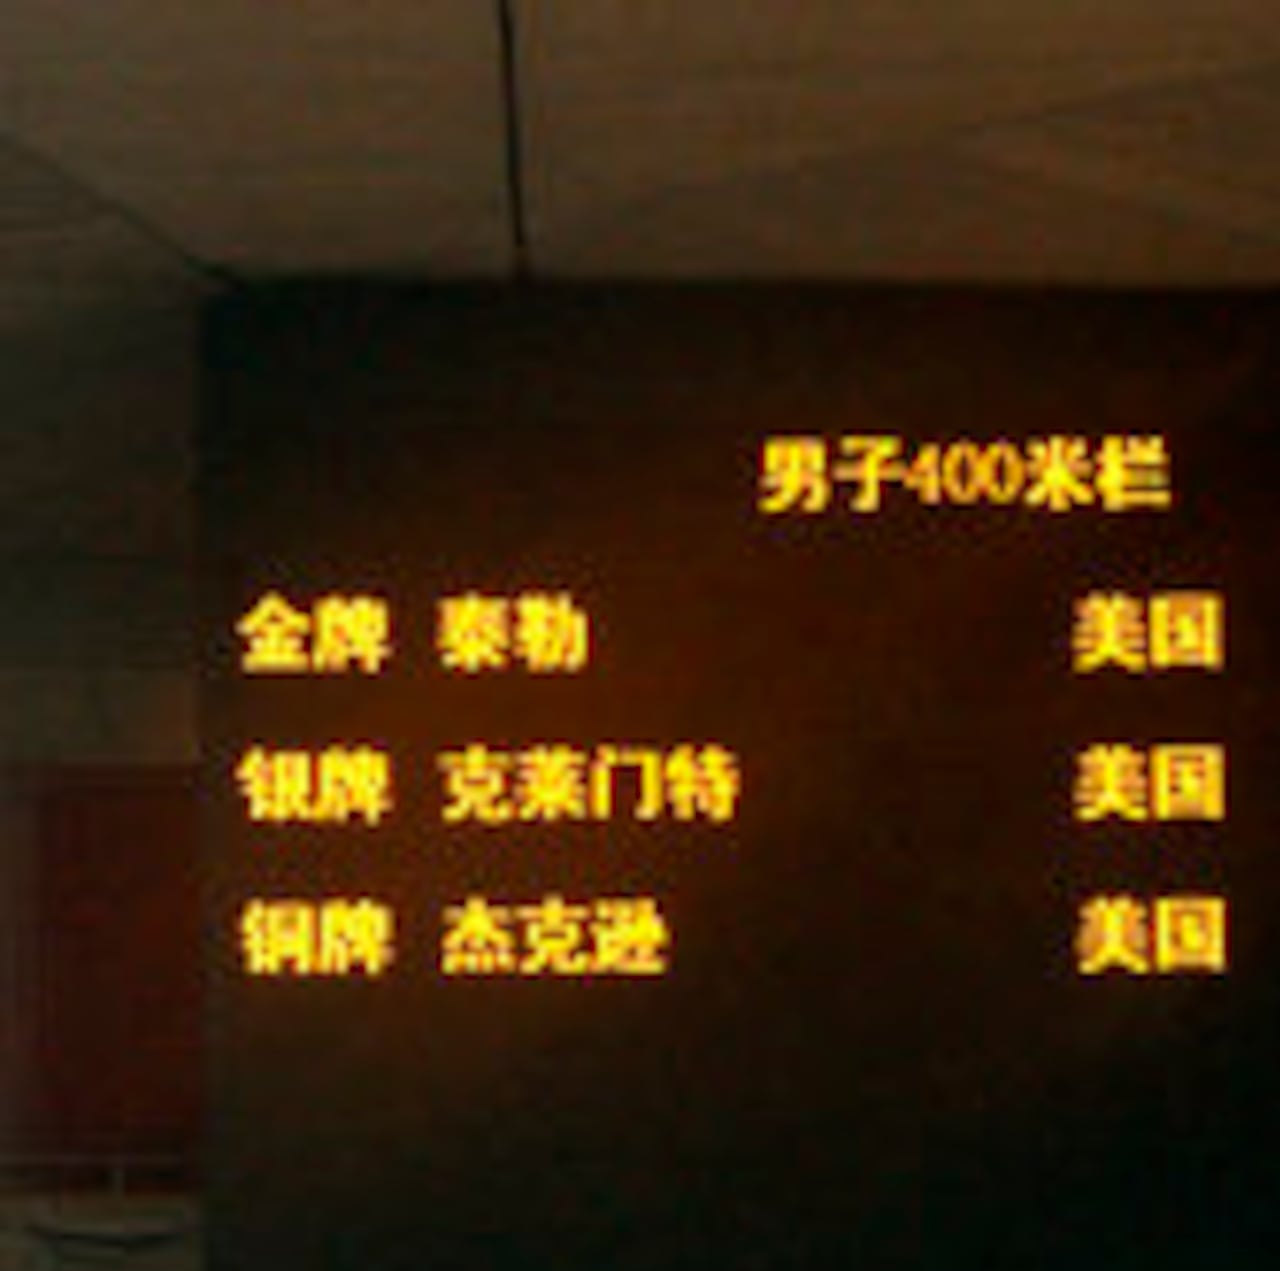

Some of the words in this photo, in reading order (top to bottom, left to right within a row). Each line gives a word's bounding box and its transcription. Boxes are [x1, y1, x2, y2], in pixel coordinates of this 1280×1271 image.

[760, 435, 1172, 513] 男子400米栏
[237, 593, 392, 674] 金牌
[438, 593, 590, 673] 泰勒
[1071, 593, 1225, 672] 美国
[237, 746, 393, 824] 银牌
[440, 745, 741, 824] 克莱门特
[1074, 745, 1225, 821] 美国
[239, 897, 394, 975] 铜牌
[1078, 896, 1228, 974] 美国
